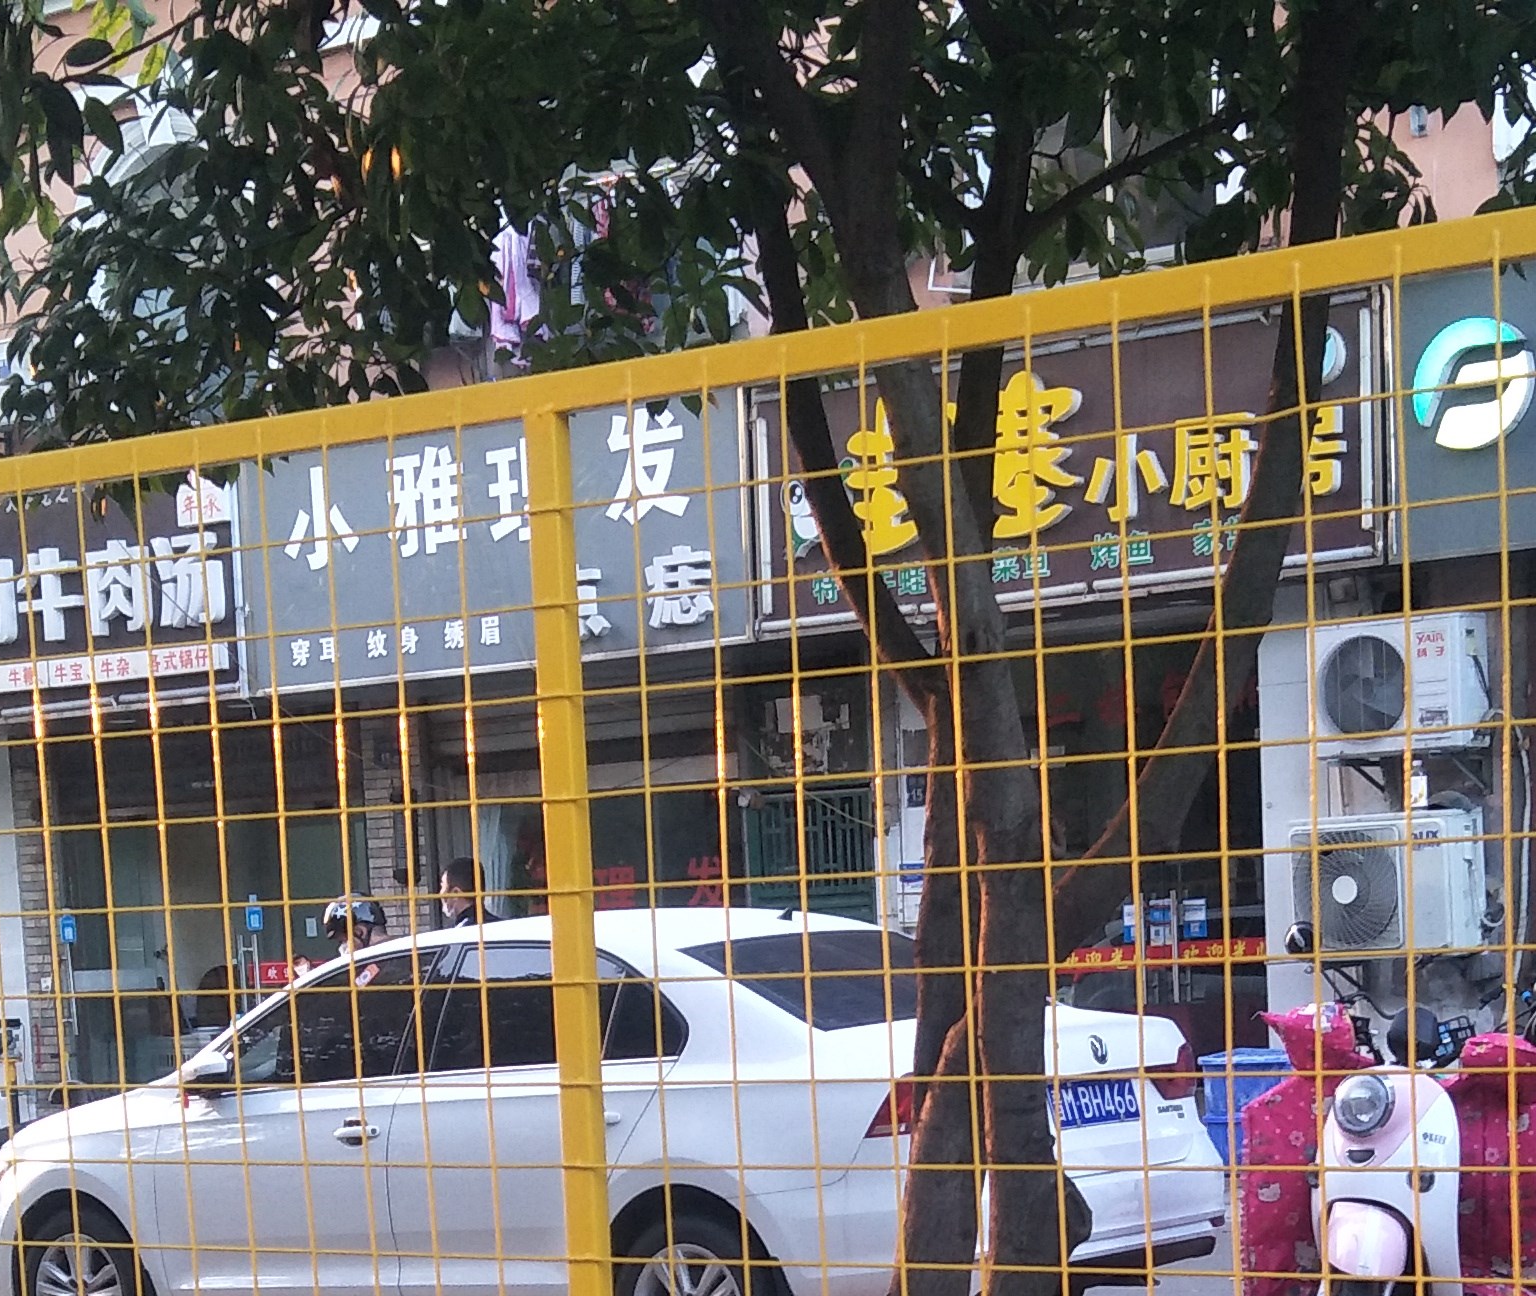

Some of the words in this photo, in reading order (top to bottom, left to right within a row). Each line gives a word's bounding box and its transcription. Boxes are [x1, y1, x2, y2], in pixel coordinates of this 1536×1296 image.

[1090, 529, 1154, 571] 烤鱼
[290, 635, 337, 667] 穿耳
[366, 623, 419, 659] 纹身
[443, 615, 501, 651] 绣眉
